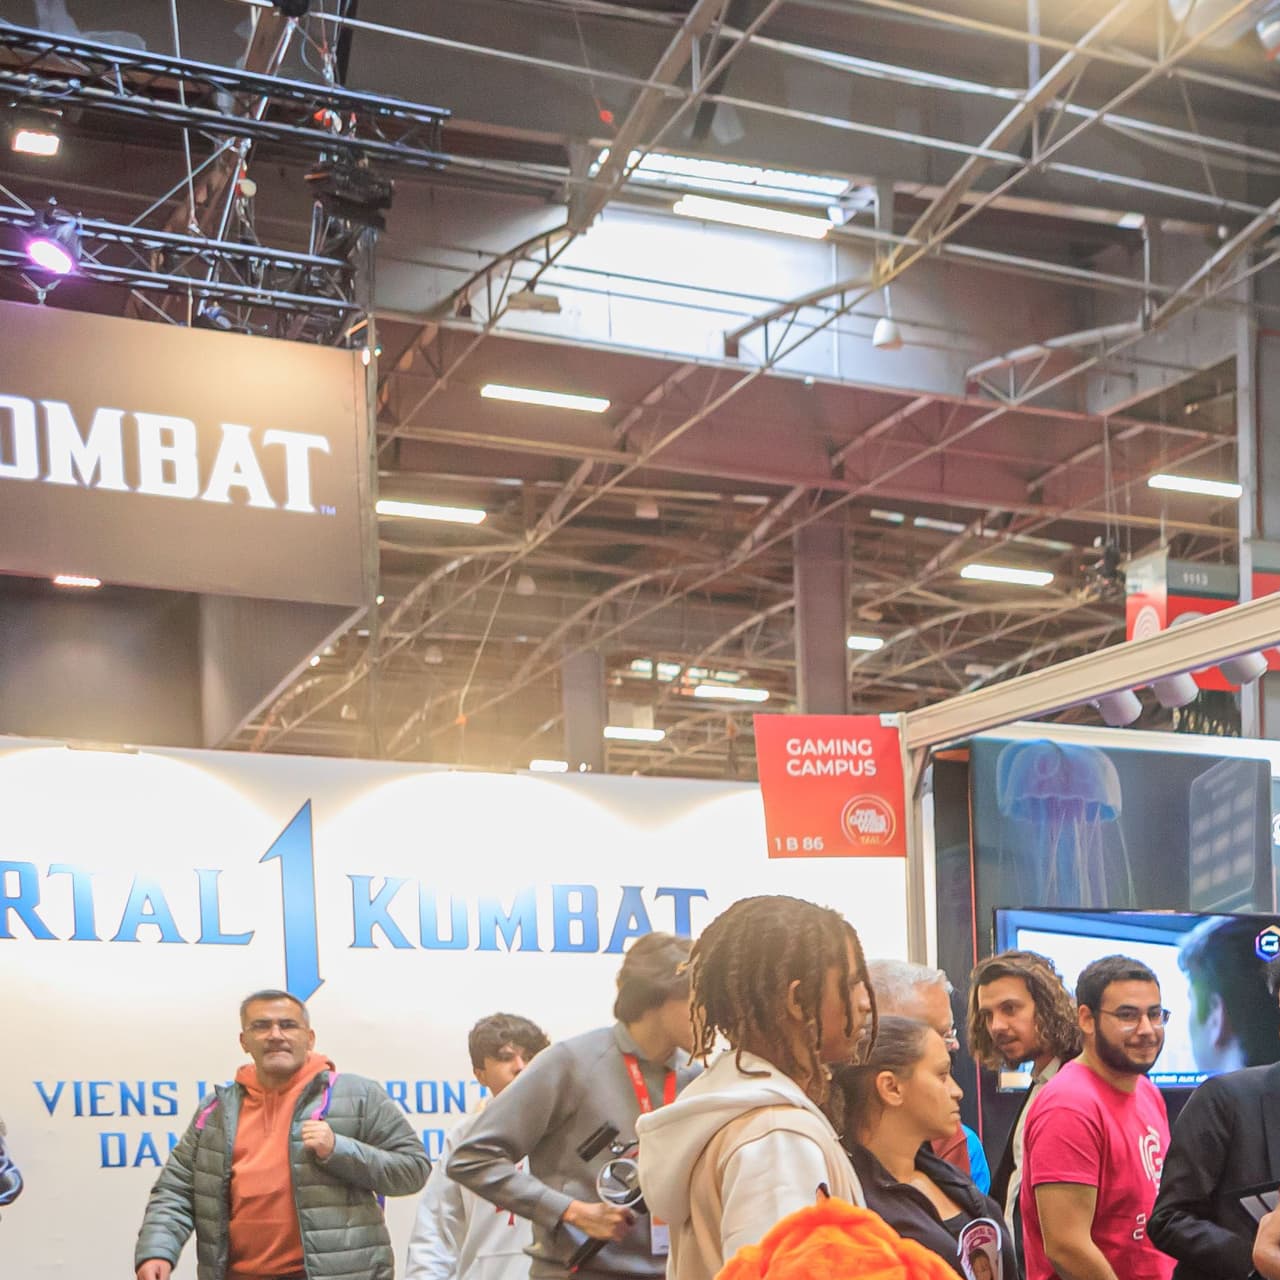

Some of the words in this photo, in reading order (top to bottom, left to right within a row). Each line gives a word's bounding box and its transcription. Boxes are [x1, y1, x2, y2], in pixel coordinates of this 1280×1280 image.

[785, 738, 873, 756] GAMING
[785, 759, 877, 777] CAMPUS
[33, 1080, 179, 1117] VIENS
